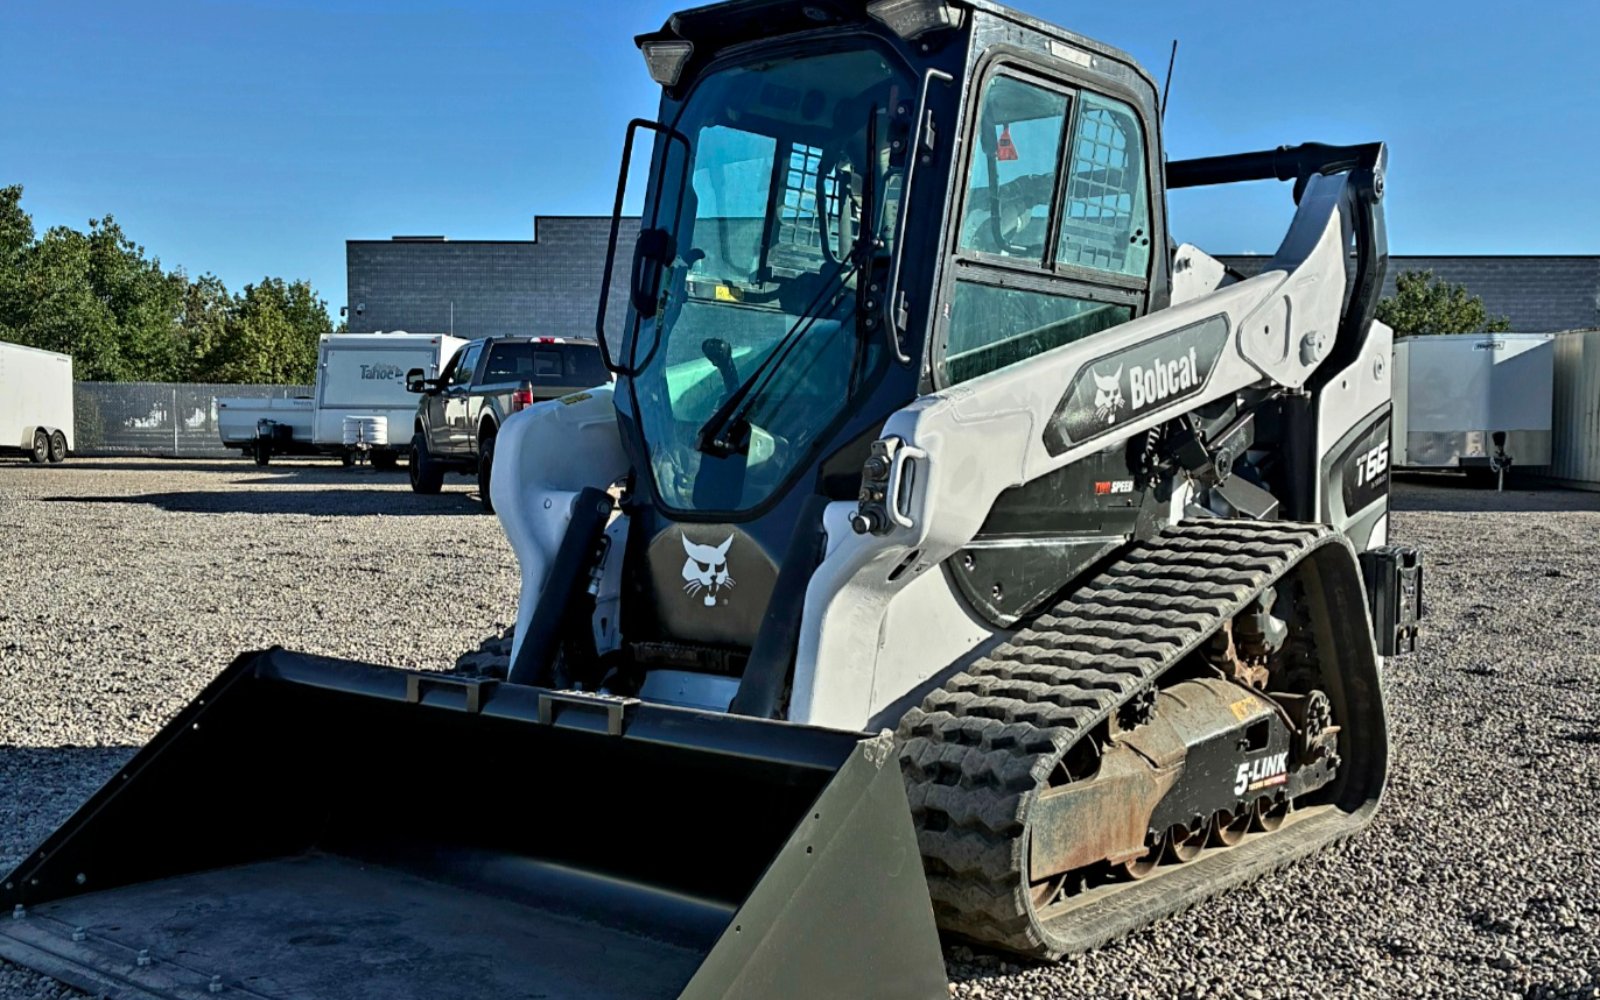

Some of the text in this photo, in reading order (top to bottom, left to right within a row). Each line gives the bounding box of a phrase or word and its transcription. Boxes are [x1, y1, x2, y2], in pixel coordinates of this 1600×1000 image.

[360, 364, 394, 380] Tahoe
[1130, 347, 1199, 410] Bobcat
[1356, 439, 1389, 487] T66
[1111, 480, 1134, 494] SPEED
[1234, 752, 1289, 796] 5-LINK
